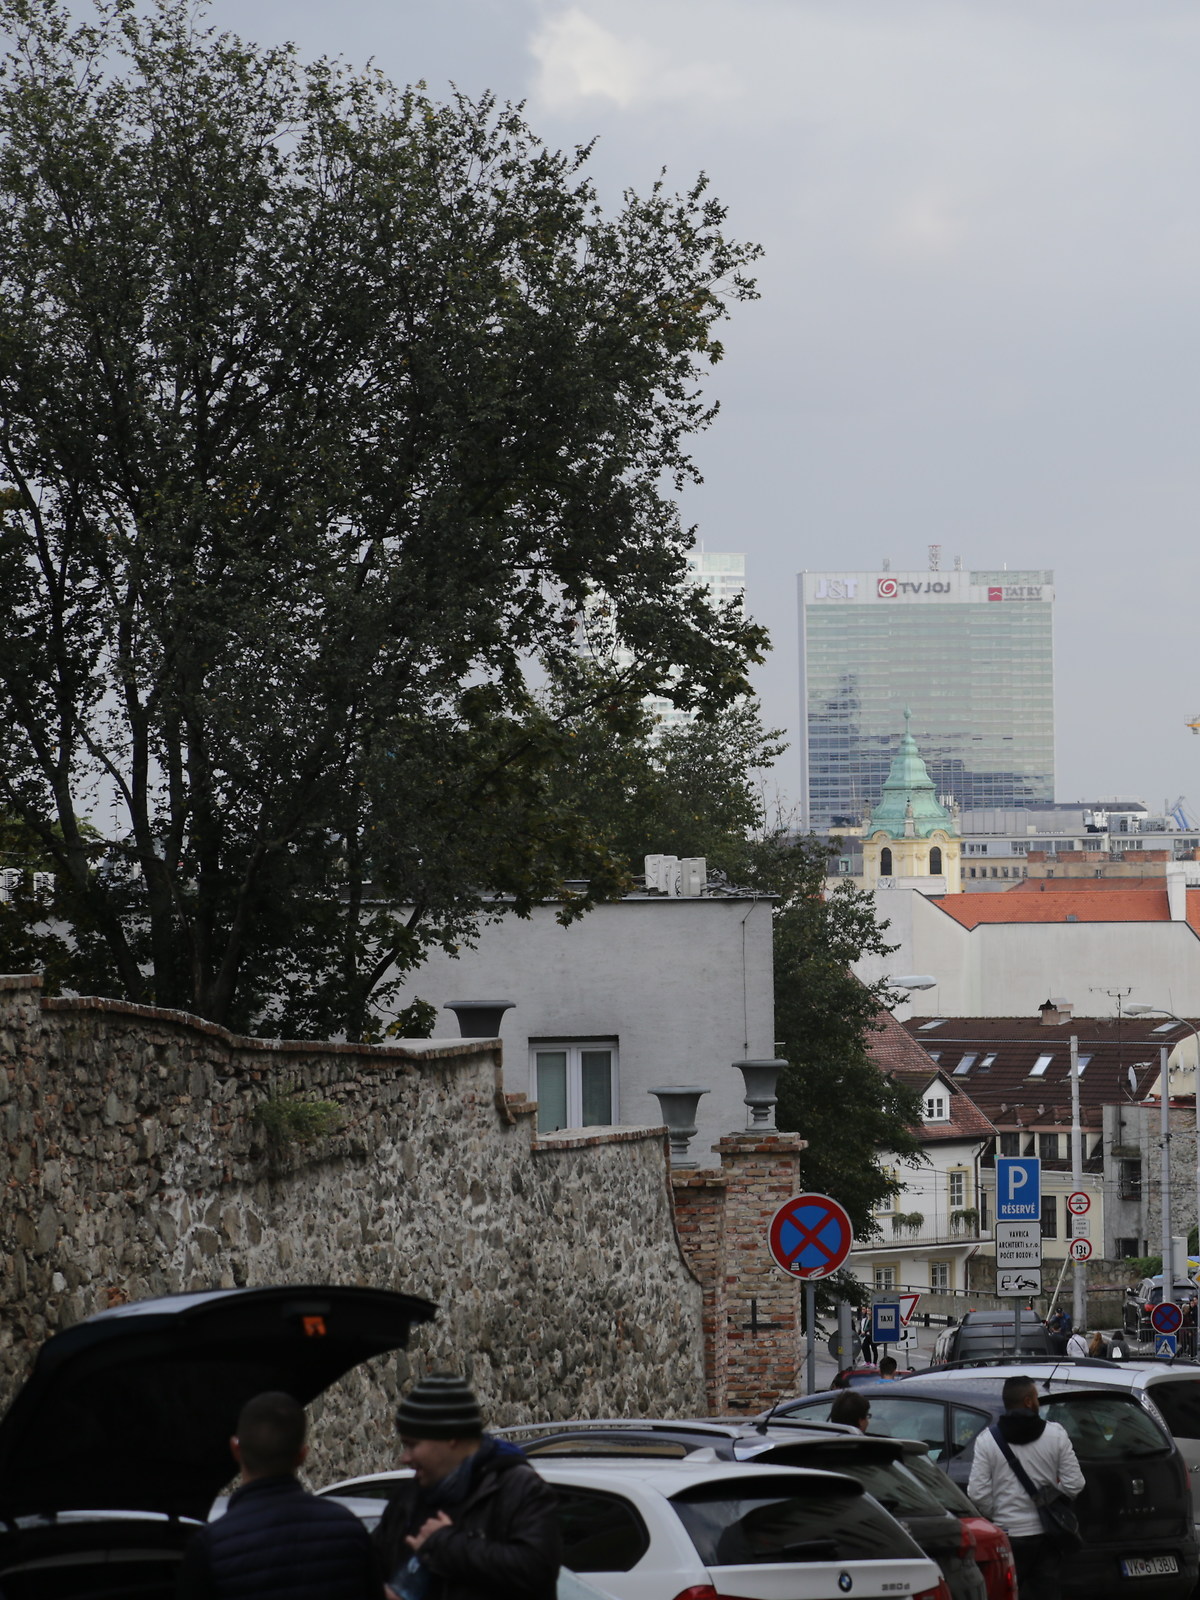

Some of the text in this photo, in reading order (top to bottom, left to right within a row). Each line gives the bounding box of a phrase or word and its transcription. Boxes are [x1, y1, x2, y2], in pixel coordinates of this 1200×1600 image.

[815, 578, 858, 599] J&T
[1004, 586, 1042, 597] TATRY
[1008, 1166, 1028, 1200] P
[1002, 1202, 1036, 1214] RÉSERVÉ
